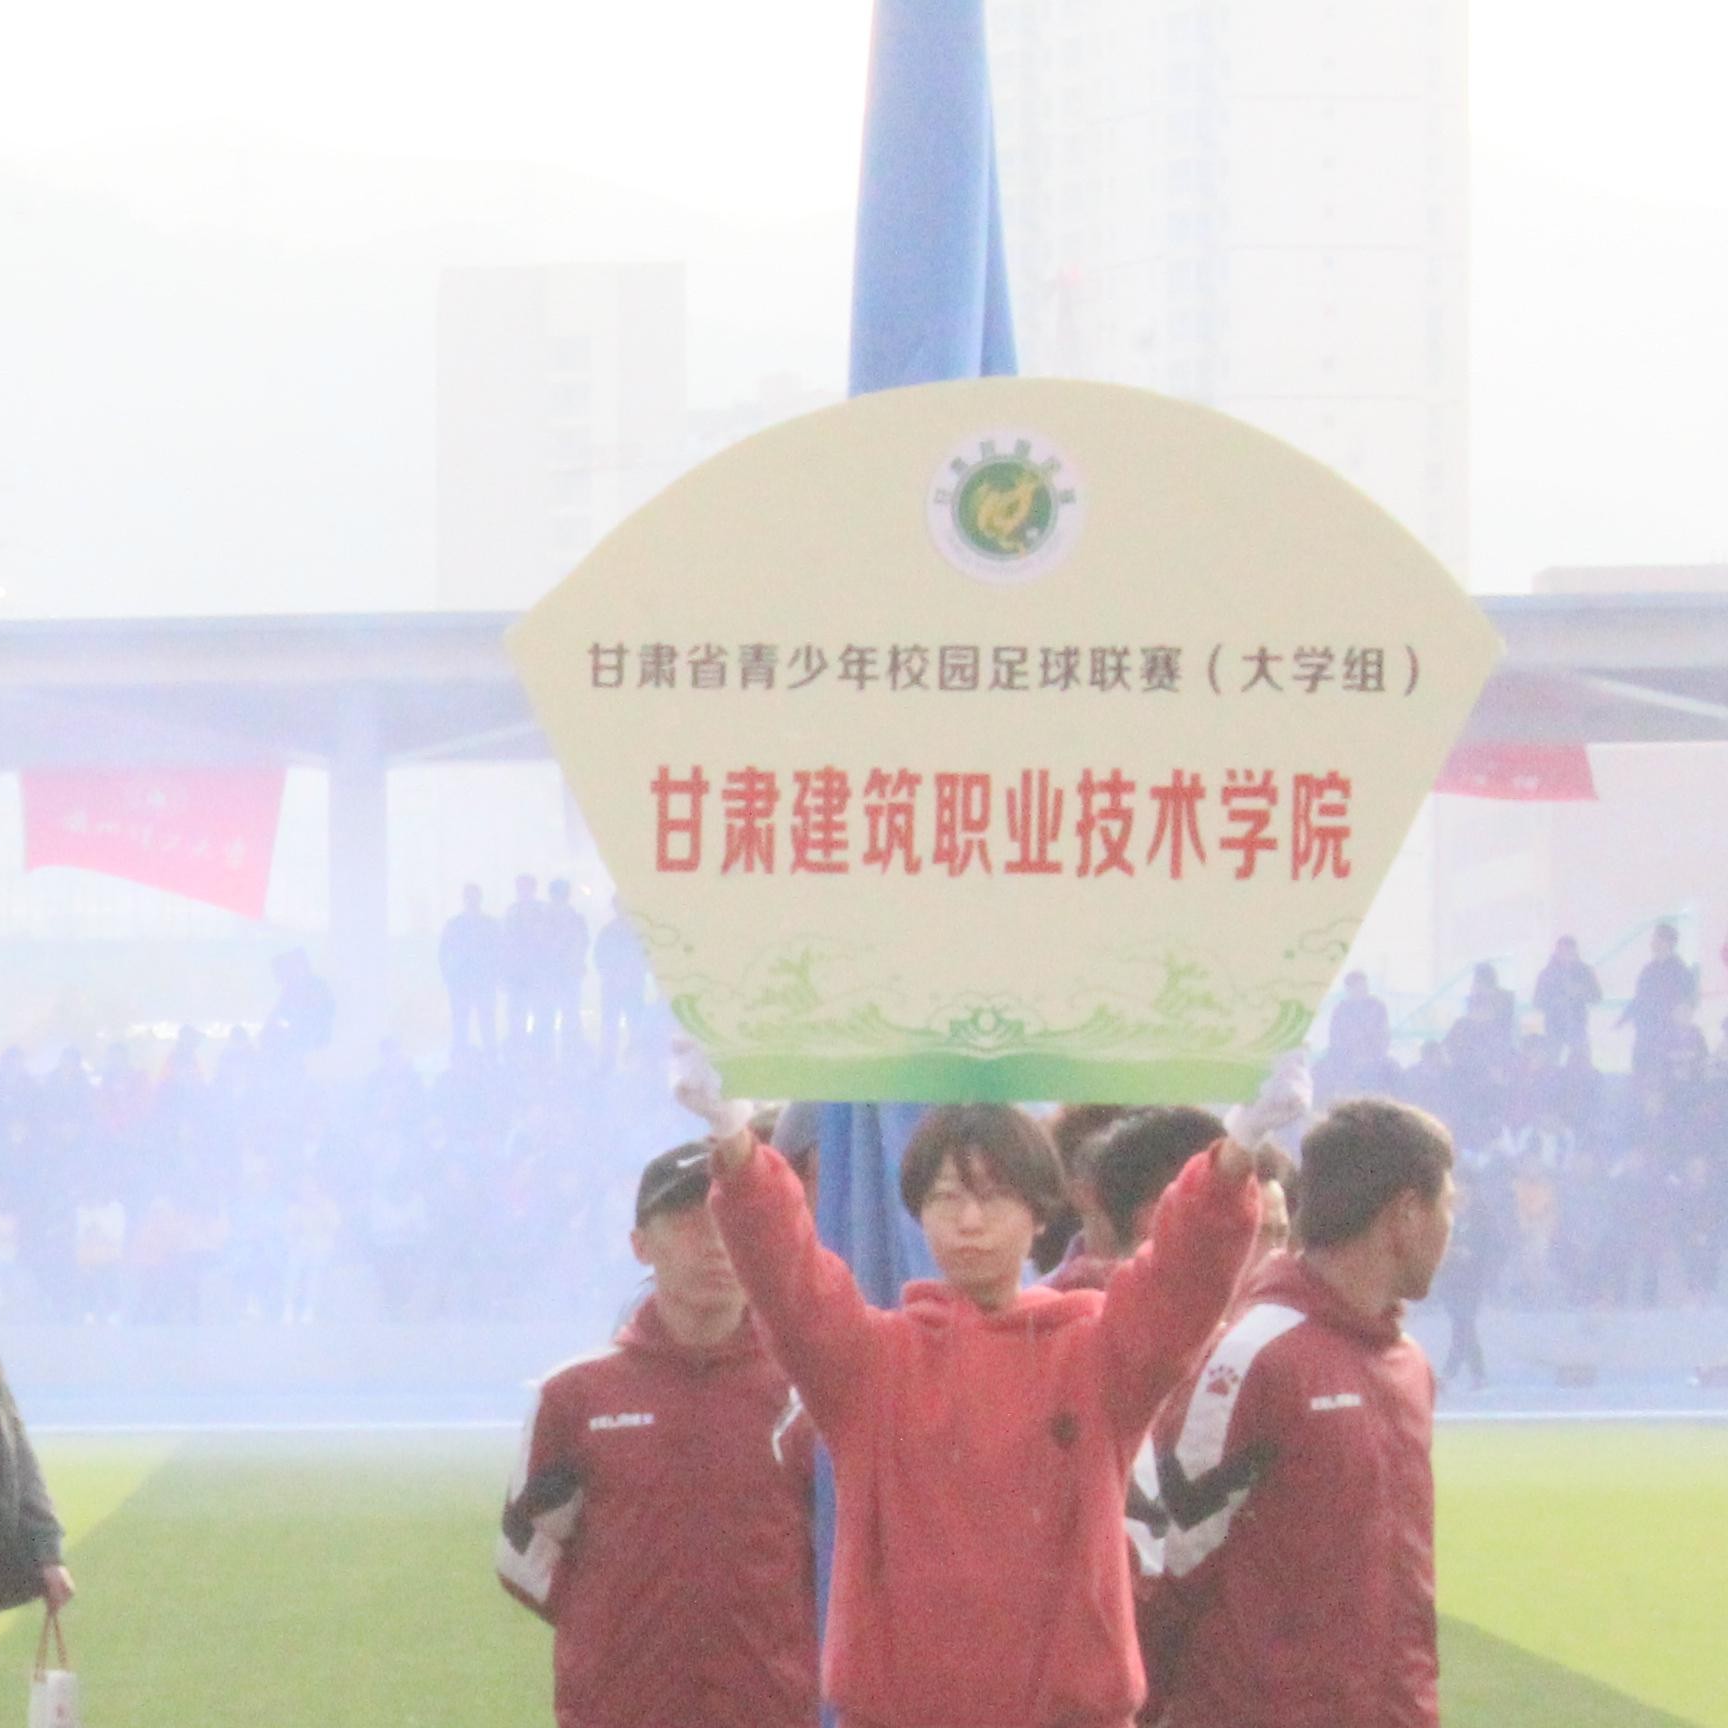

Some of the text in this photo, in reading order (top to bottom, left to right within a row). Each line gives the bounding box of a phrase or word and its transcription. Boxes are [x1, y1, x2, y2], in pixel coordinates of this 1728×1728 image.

[650, 764, 1353, 880] 甘肃建筑职业技术学院
